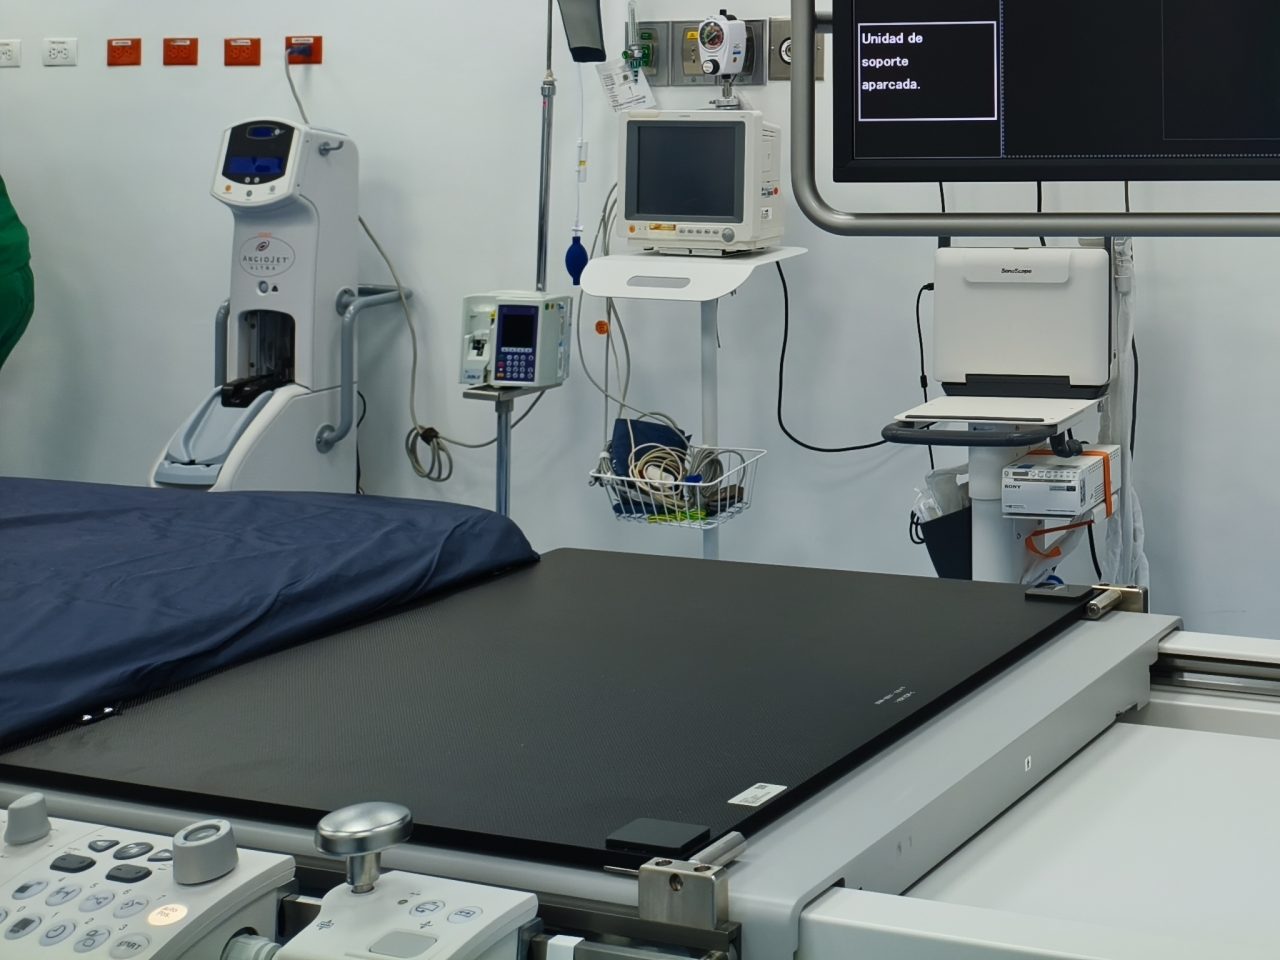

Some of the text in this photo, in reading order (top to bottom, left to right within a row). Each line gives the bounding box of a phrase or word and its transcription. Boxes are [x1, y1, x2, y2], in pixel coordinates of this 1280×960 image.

[861, 32, 923, 44] Unidad de
[861, 56, 909, 68] soporte
[861, 78, 921, 91] aparcada.
